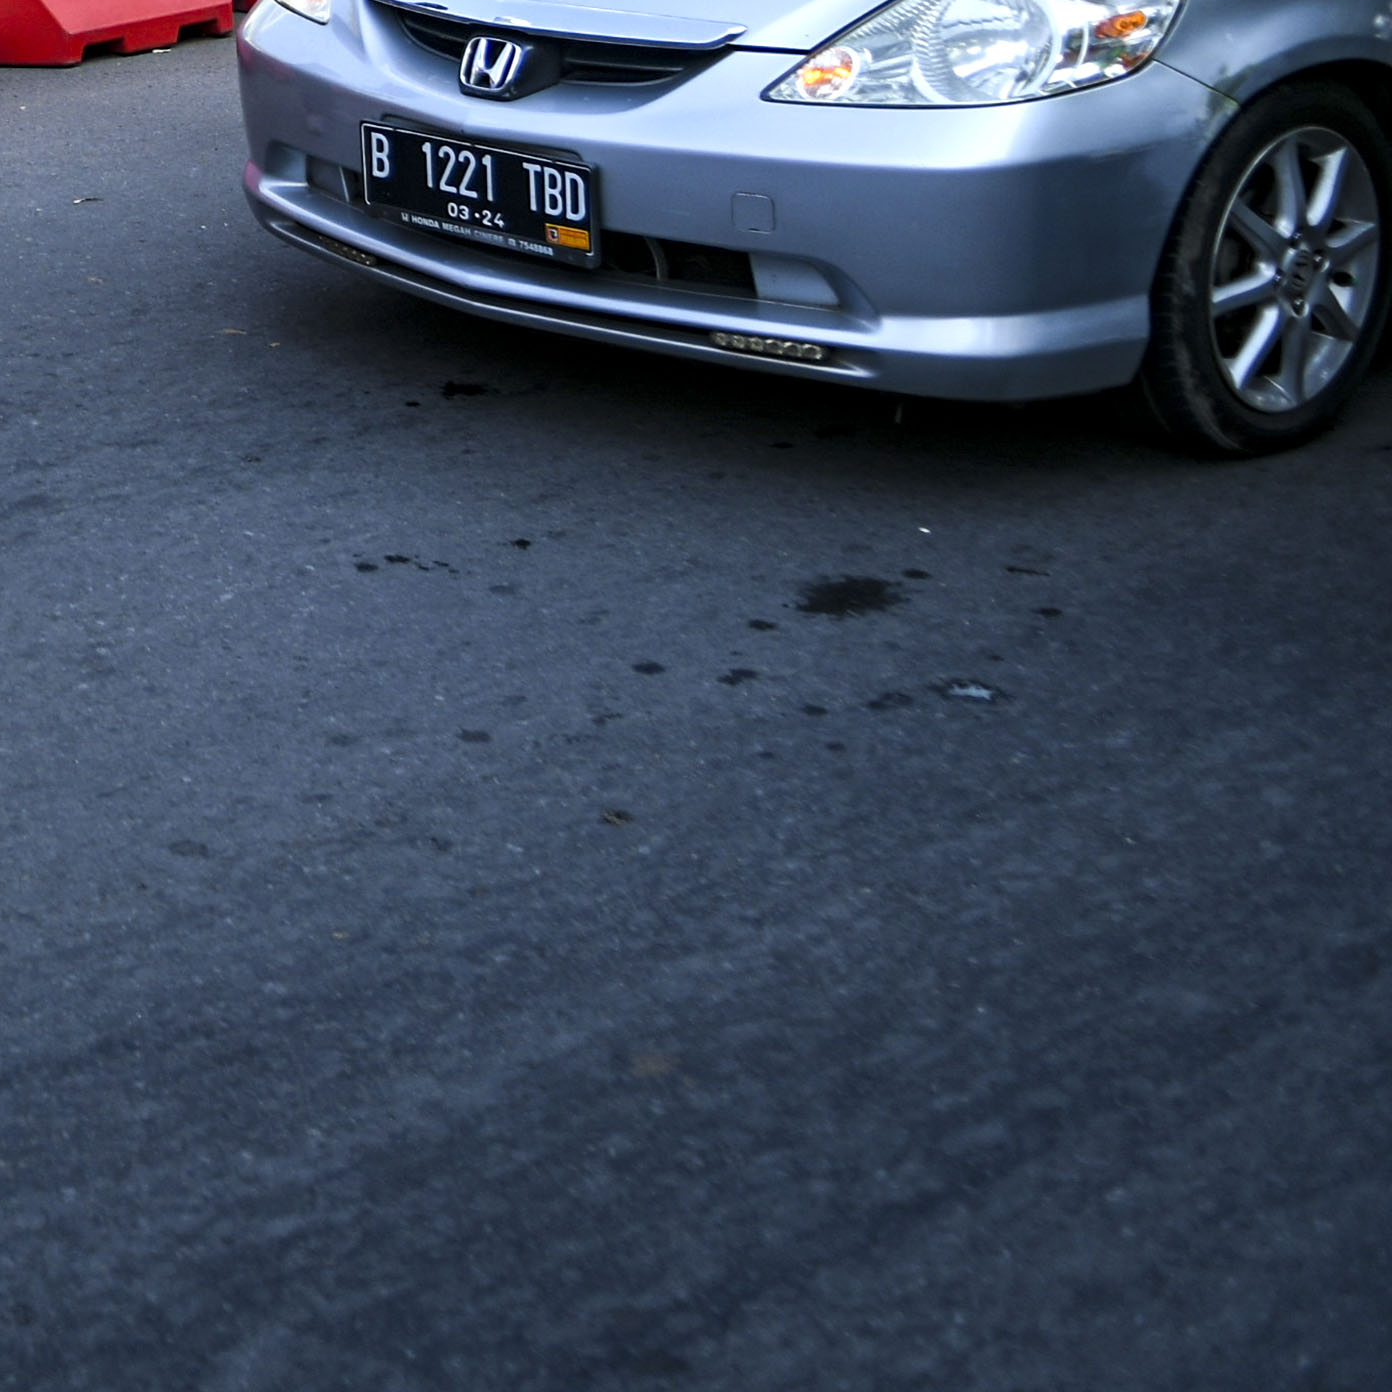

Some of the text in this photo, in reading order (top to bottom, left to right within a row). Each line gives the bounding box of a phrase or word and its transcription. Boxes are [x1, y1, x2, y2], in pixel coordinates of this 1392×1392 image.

[370, 131, 586, 221] B 1221 TBD
[412, 215, 440, 228] HONDA
